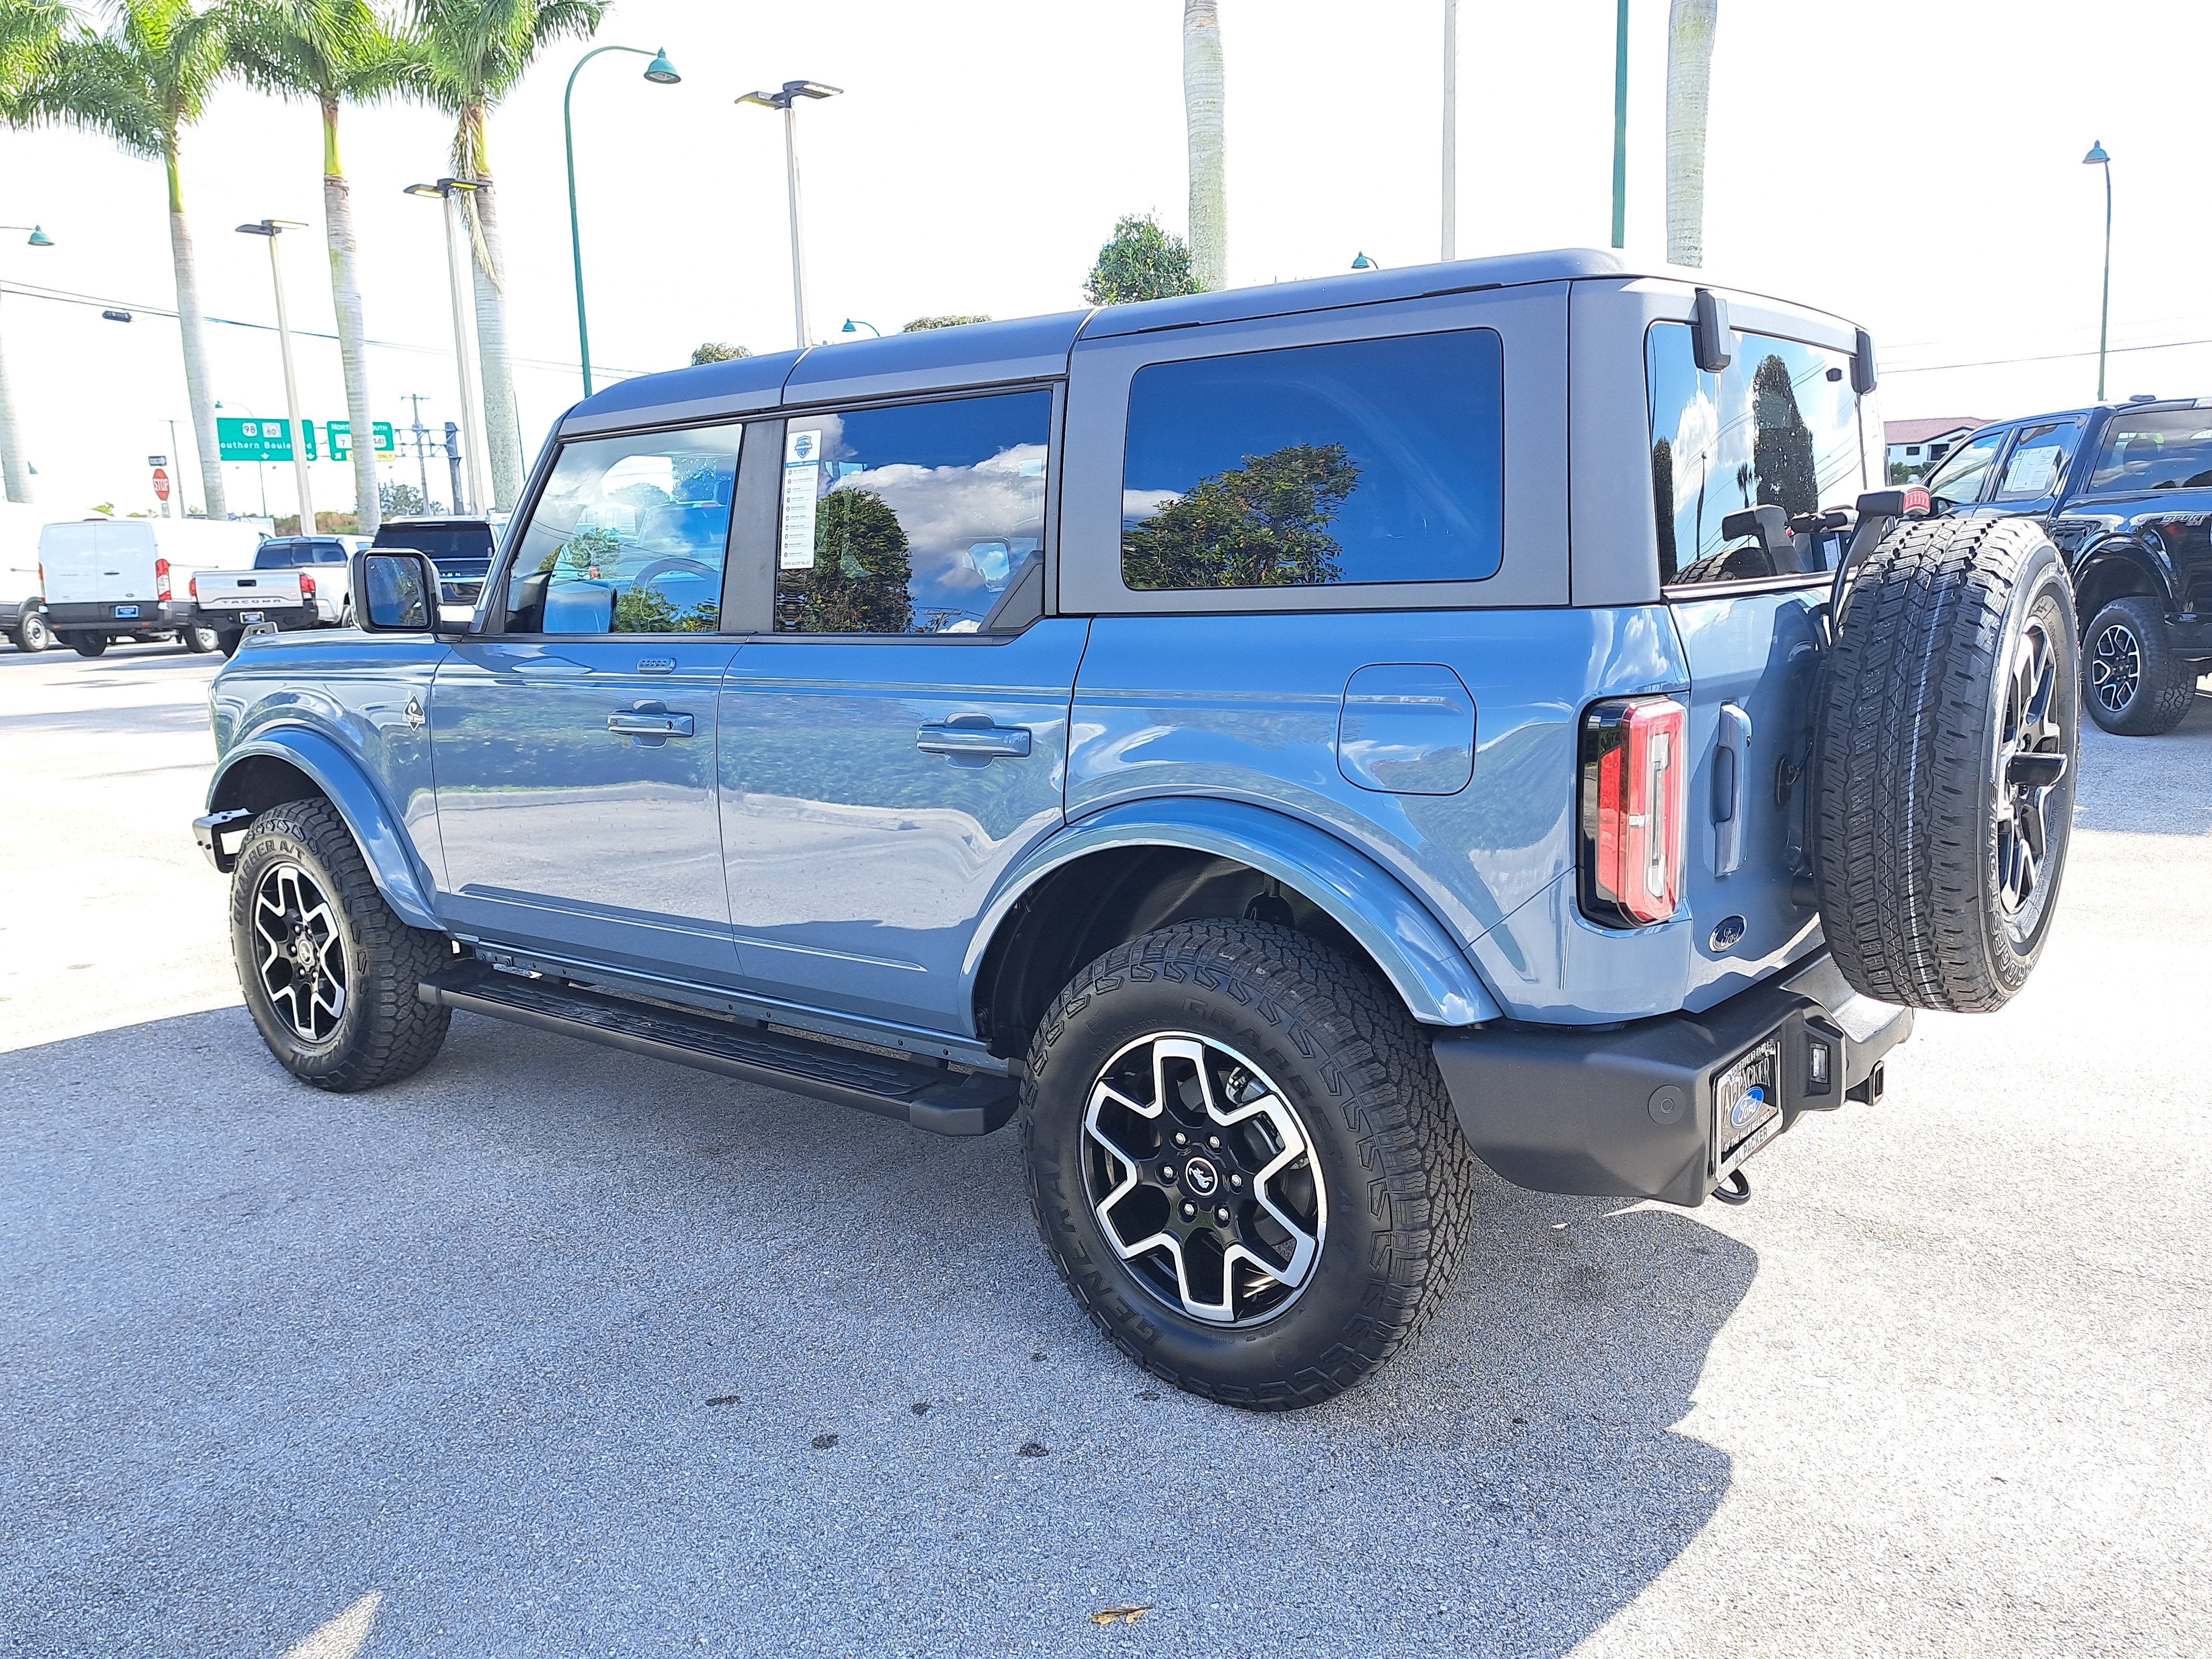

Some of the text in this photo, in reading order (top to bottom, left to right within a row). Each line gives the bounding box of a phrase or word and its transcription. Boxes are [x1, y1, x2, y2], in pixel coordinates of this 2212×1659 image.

[243, 425, 255, 434] 98
[221, 441, 311, 449] outhern Bouled
[154, 478, 168, 491] STOP
[2159, 514, 2210, 525] SPORT
[234, 839, 305, 926] GRABBER A/T
[1737, 1057, 1771, 1098] PACKER
[1737, 1094, 1759, 1123] Ford
[1724, 1139, 1730, 1152] OF
[1731, 1133, 1739, 1148] THE
[1735, 1126, 1768, 1167] AL PACKER
